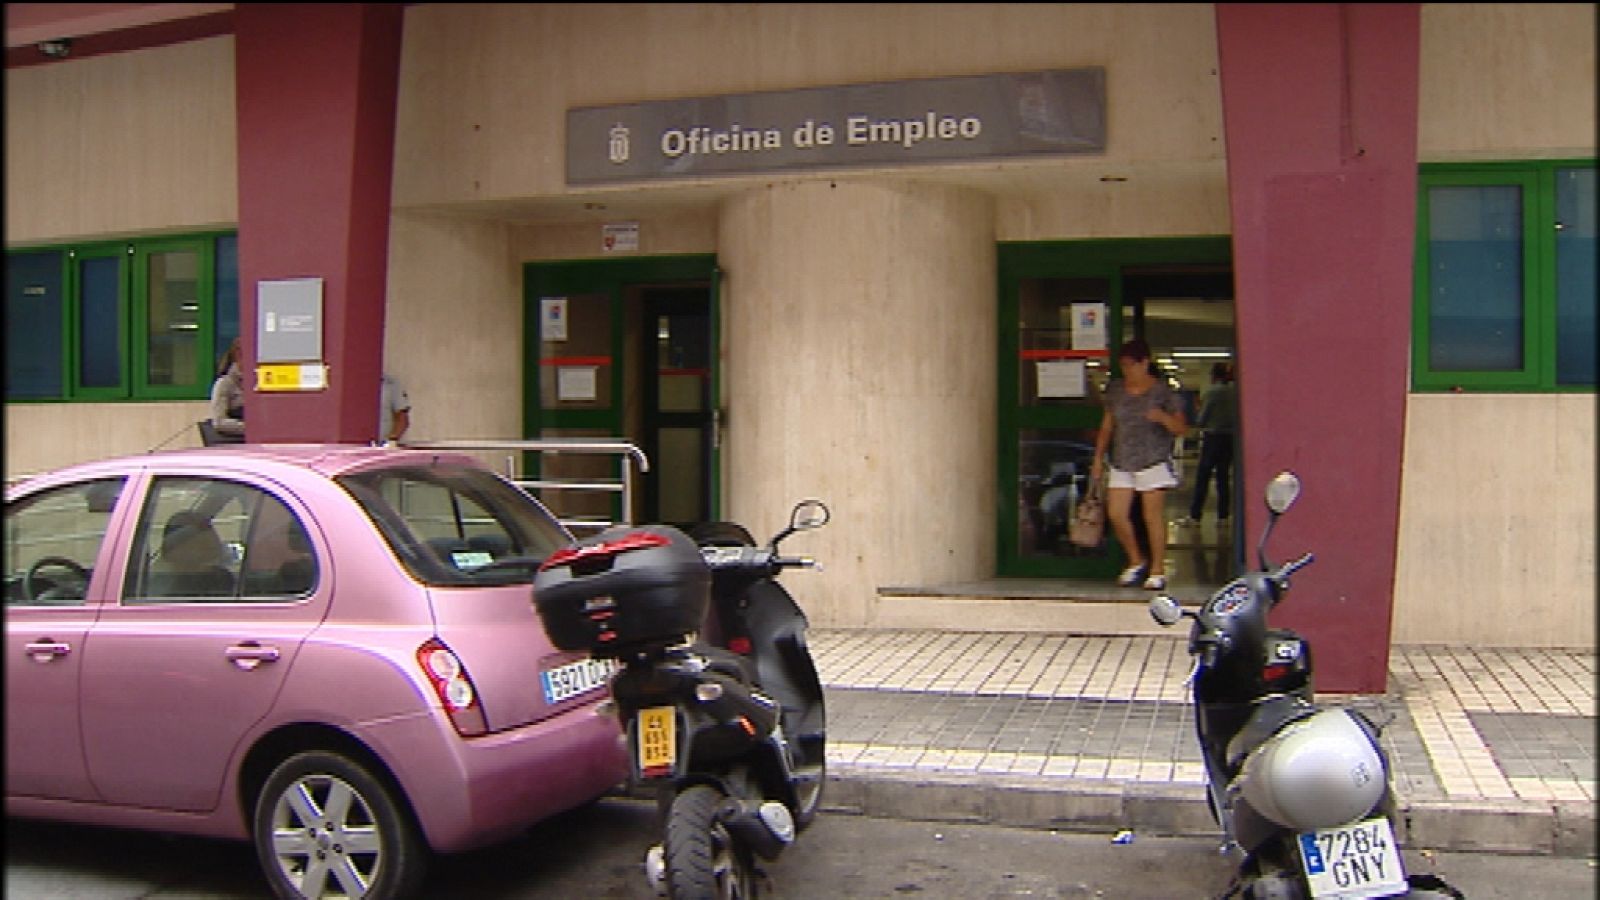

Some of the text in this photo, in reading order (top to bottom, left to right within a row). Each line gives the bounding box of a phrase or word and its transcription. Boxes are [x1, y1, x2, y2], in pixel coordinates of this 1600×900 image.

[661, 111, 982, 156] Oficina de Empleo
[1320, 825, 1386, 863] 7284
[1332, 853, 1385, 888] GNY
